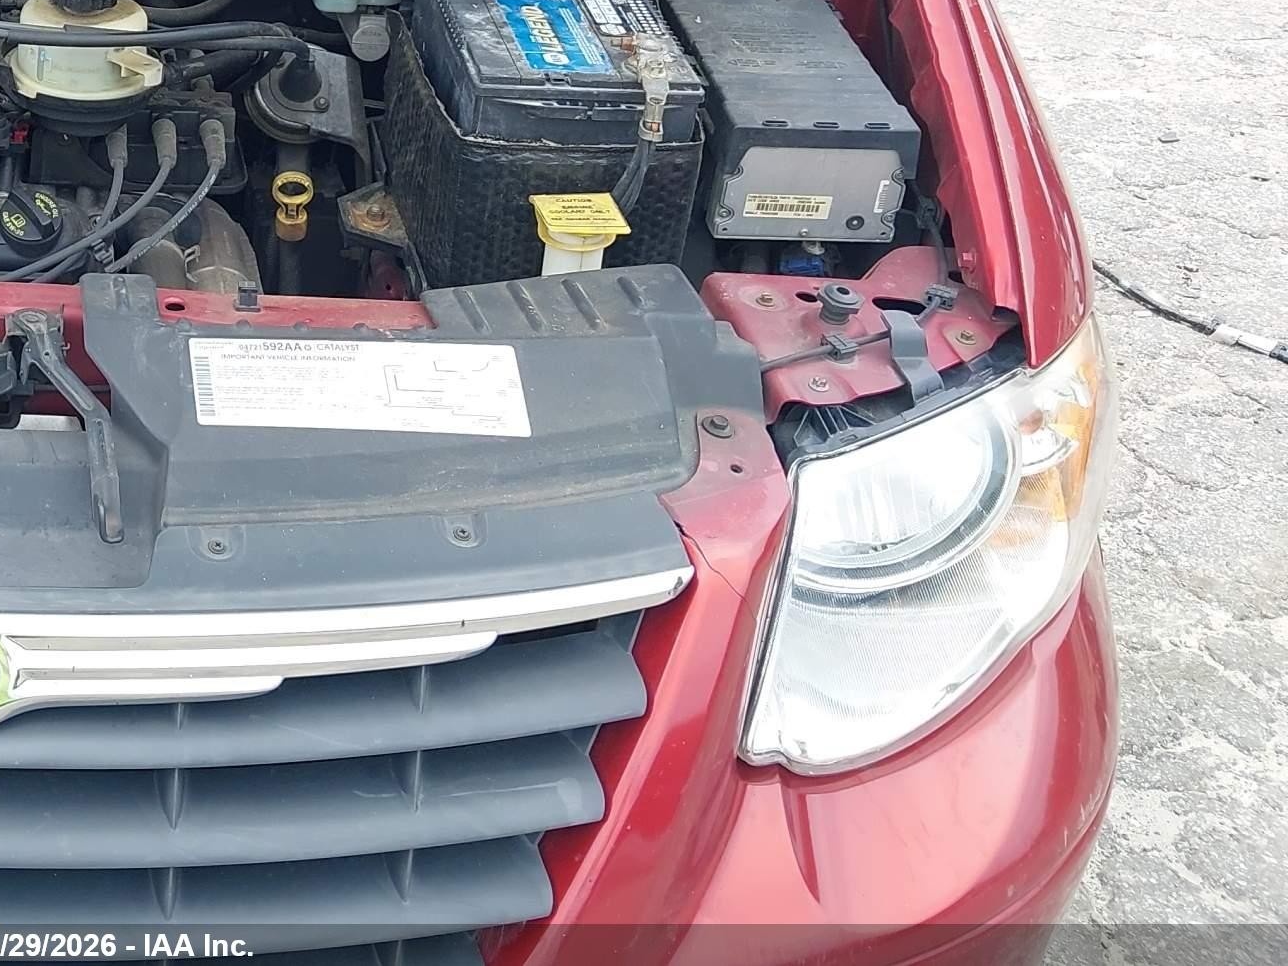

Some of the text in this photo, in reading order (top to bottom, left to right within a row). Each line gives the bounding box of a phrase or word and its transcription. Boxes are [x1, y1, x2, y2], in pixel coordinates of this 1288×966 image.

[520, 5, 564, 52] LEGEND
[316, 343, 360, 351] CATALYST
[221, 353, 265, 361] IMPORTANT
